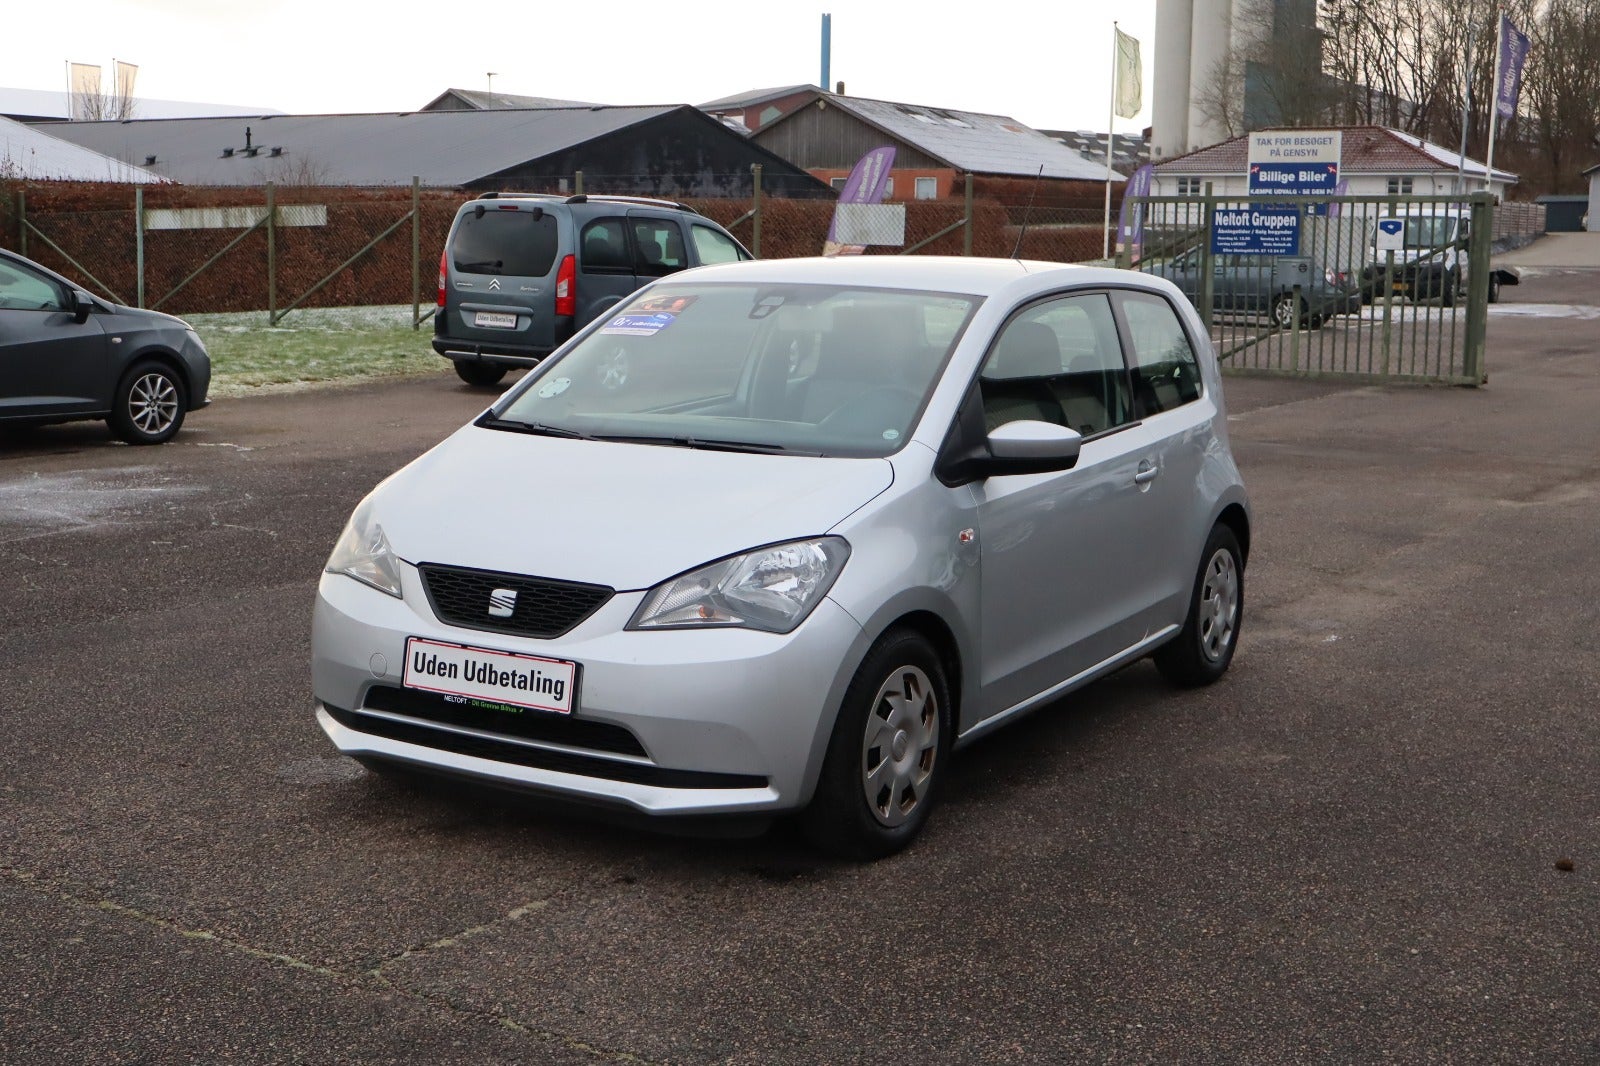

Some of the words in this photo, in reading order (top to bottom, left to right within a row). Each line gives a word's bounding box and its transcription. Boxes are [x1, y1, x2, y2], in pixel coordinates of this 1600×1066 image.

[1256, 138, 1272, 146] TAK
[1274, 138, 1291, 146] FOR
[1294, 137, 1334, 146] BESØGET
[1270, 147, 1281, 157] PÅ
[1283, 149, 1318, 157] GENSYN
[1259, 170, 1295, 184] Billige
[1298, 170, 1327, 182] Biler
[1215, 212, 1249, 226] Neltoft
[1252, 212, 1296, 229] Gruppen
[413, 651, 458, 679] Uden
[463, 659, 565, 702] Udbetaling
